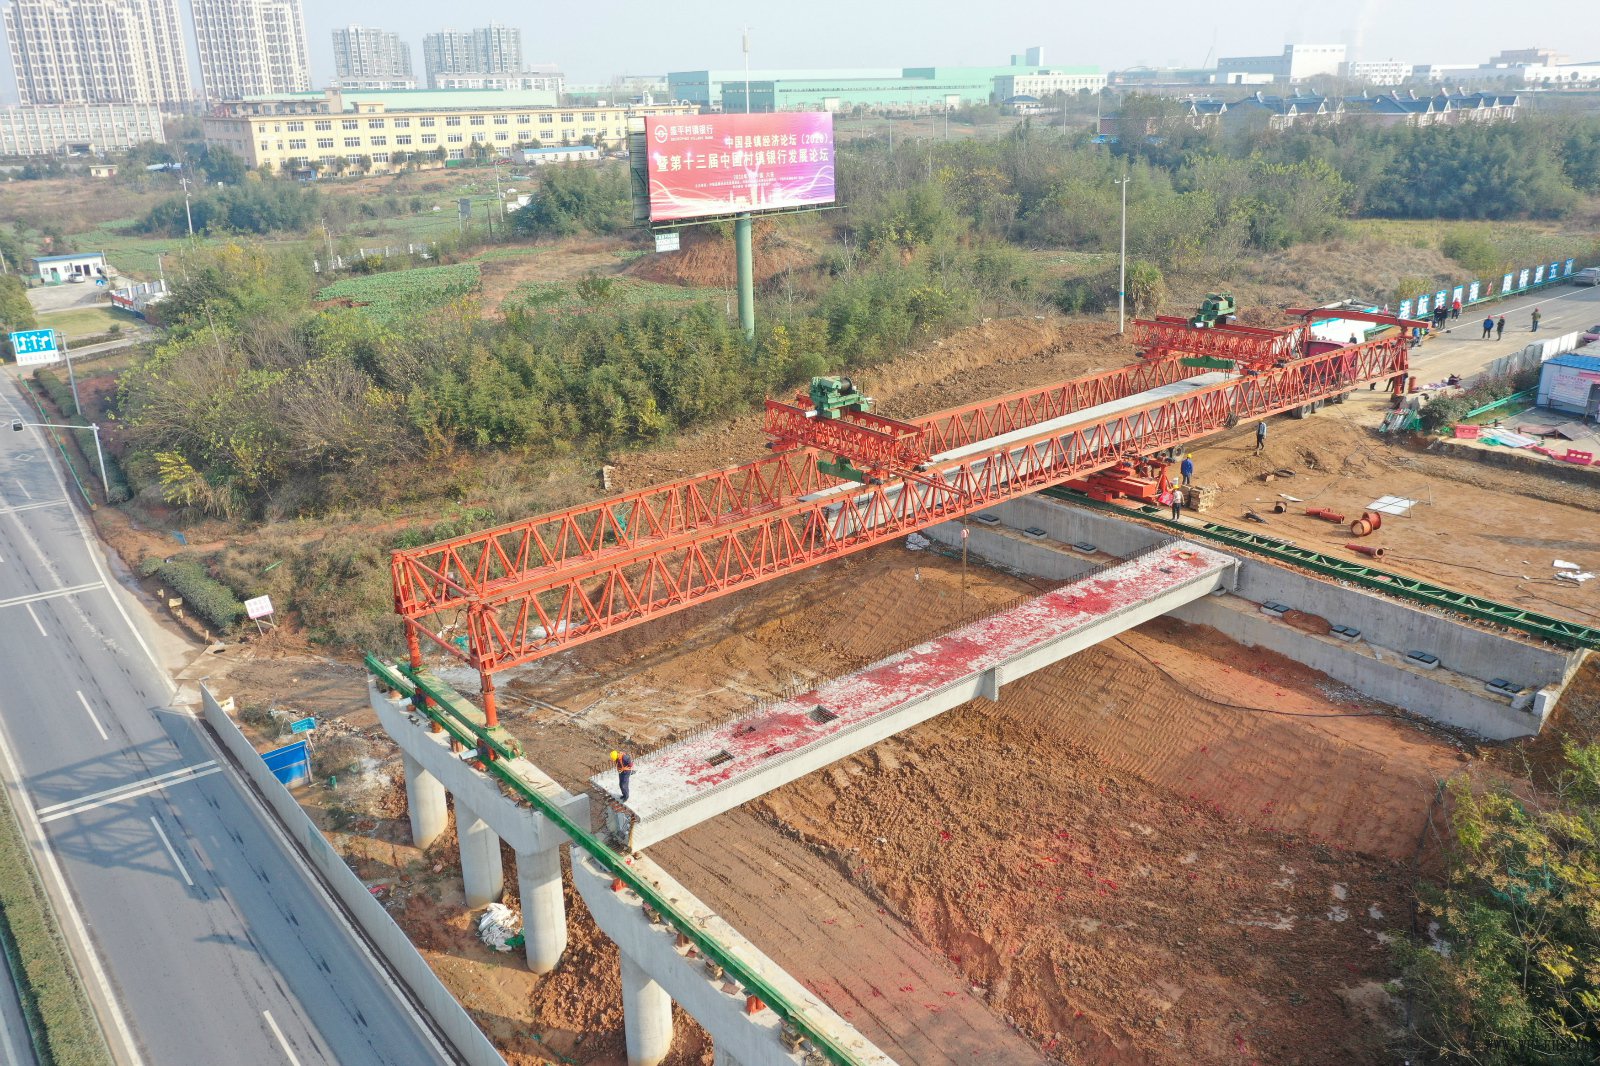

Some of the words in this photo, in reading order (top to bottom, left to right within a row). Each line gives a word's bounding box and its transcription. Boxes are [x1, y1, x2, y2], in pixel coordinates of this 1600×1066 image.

[656, 147, 829, 172] 暨第十三届中国村镇银行发展论坛
